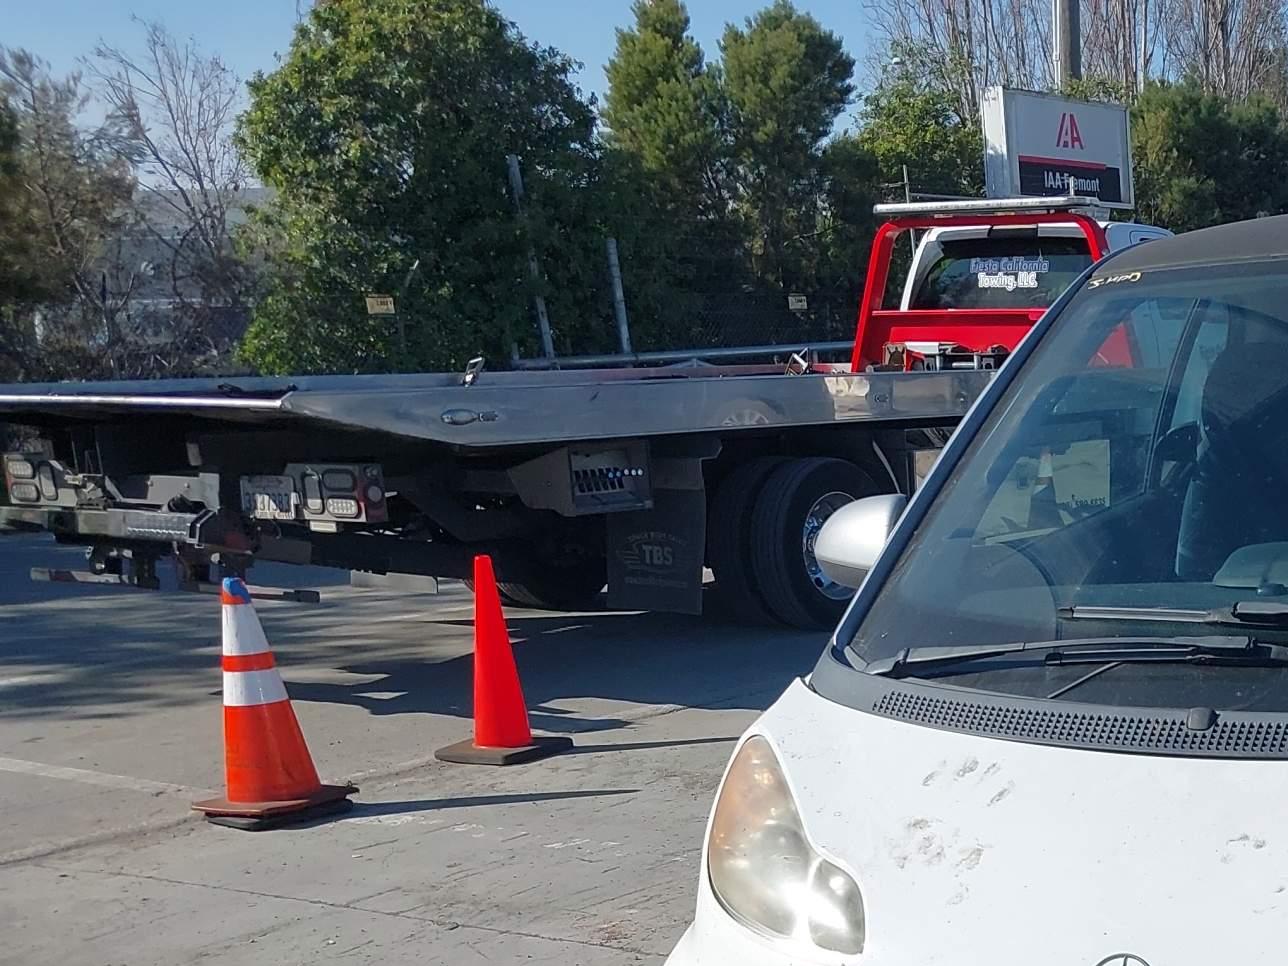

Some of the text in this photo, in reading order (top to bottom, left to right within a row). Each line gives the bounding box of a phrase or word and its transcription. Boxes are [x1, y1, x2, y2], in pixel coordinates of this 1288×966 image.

[970, 256, 1049, 274] Fiesta California
[642, 544, 673, 565] TBS
